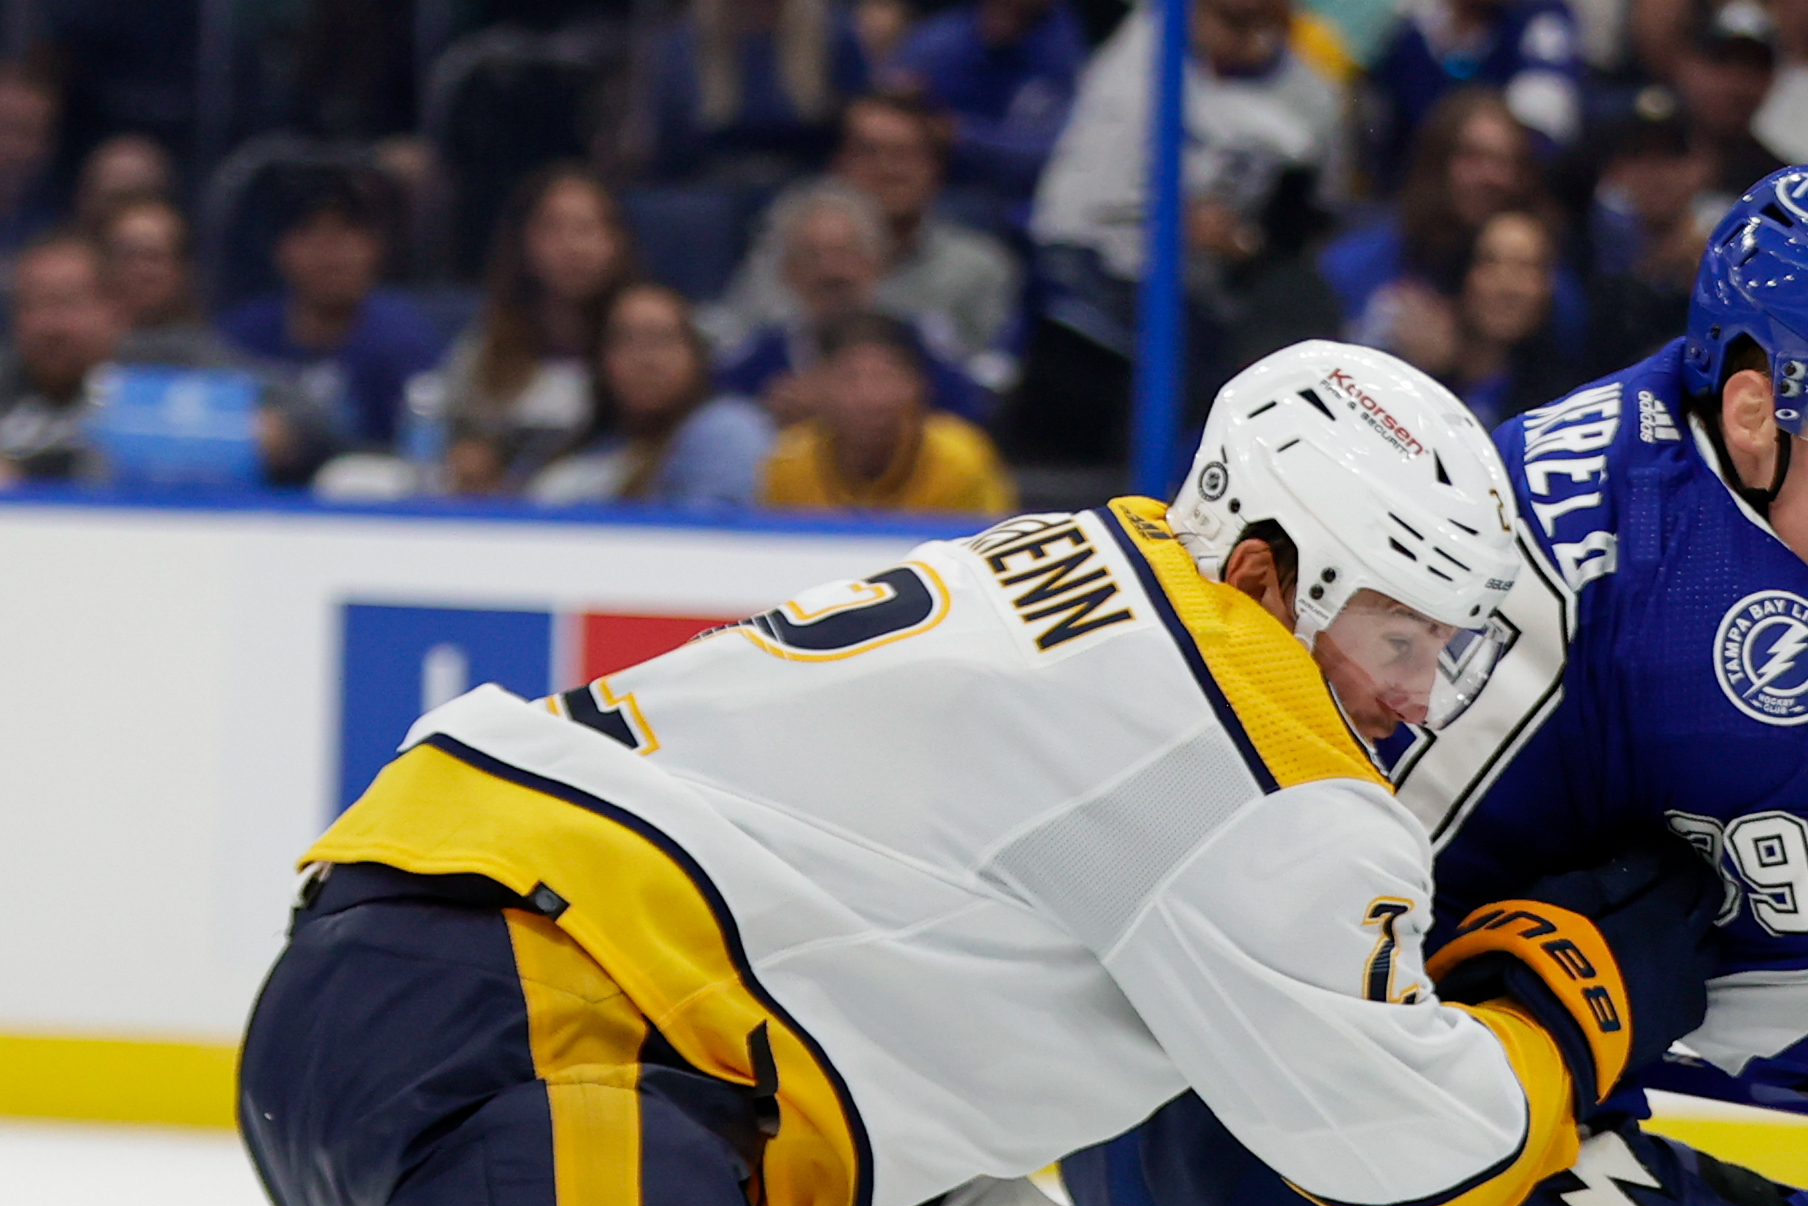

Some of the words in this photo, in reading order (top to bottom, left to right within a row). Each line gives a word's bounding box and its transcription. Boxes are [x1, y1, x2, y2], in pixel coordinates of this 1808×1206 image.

[1638, 390, 1658, 443] adidas
[1724, 616, 1752, 685] TAMPA
[1748, 598, 1787, 621] BAY
